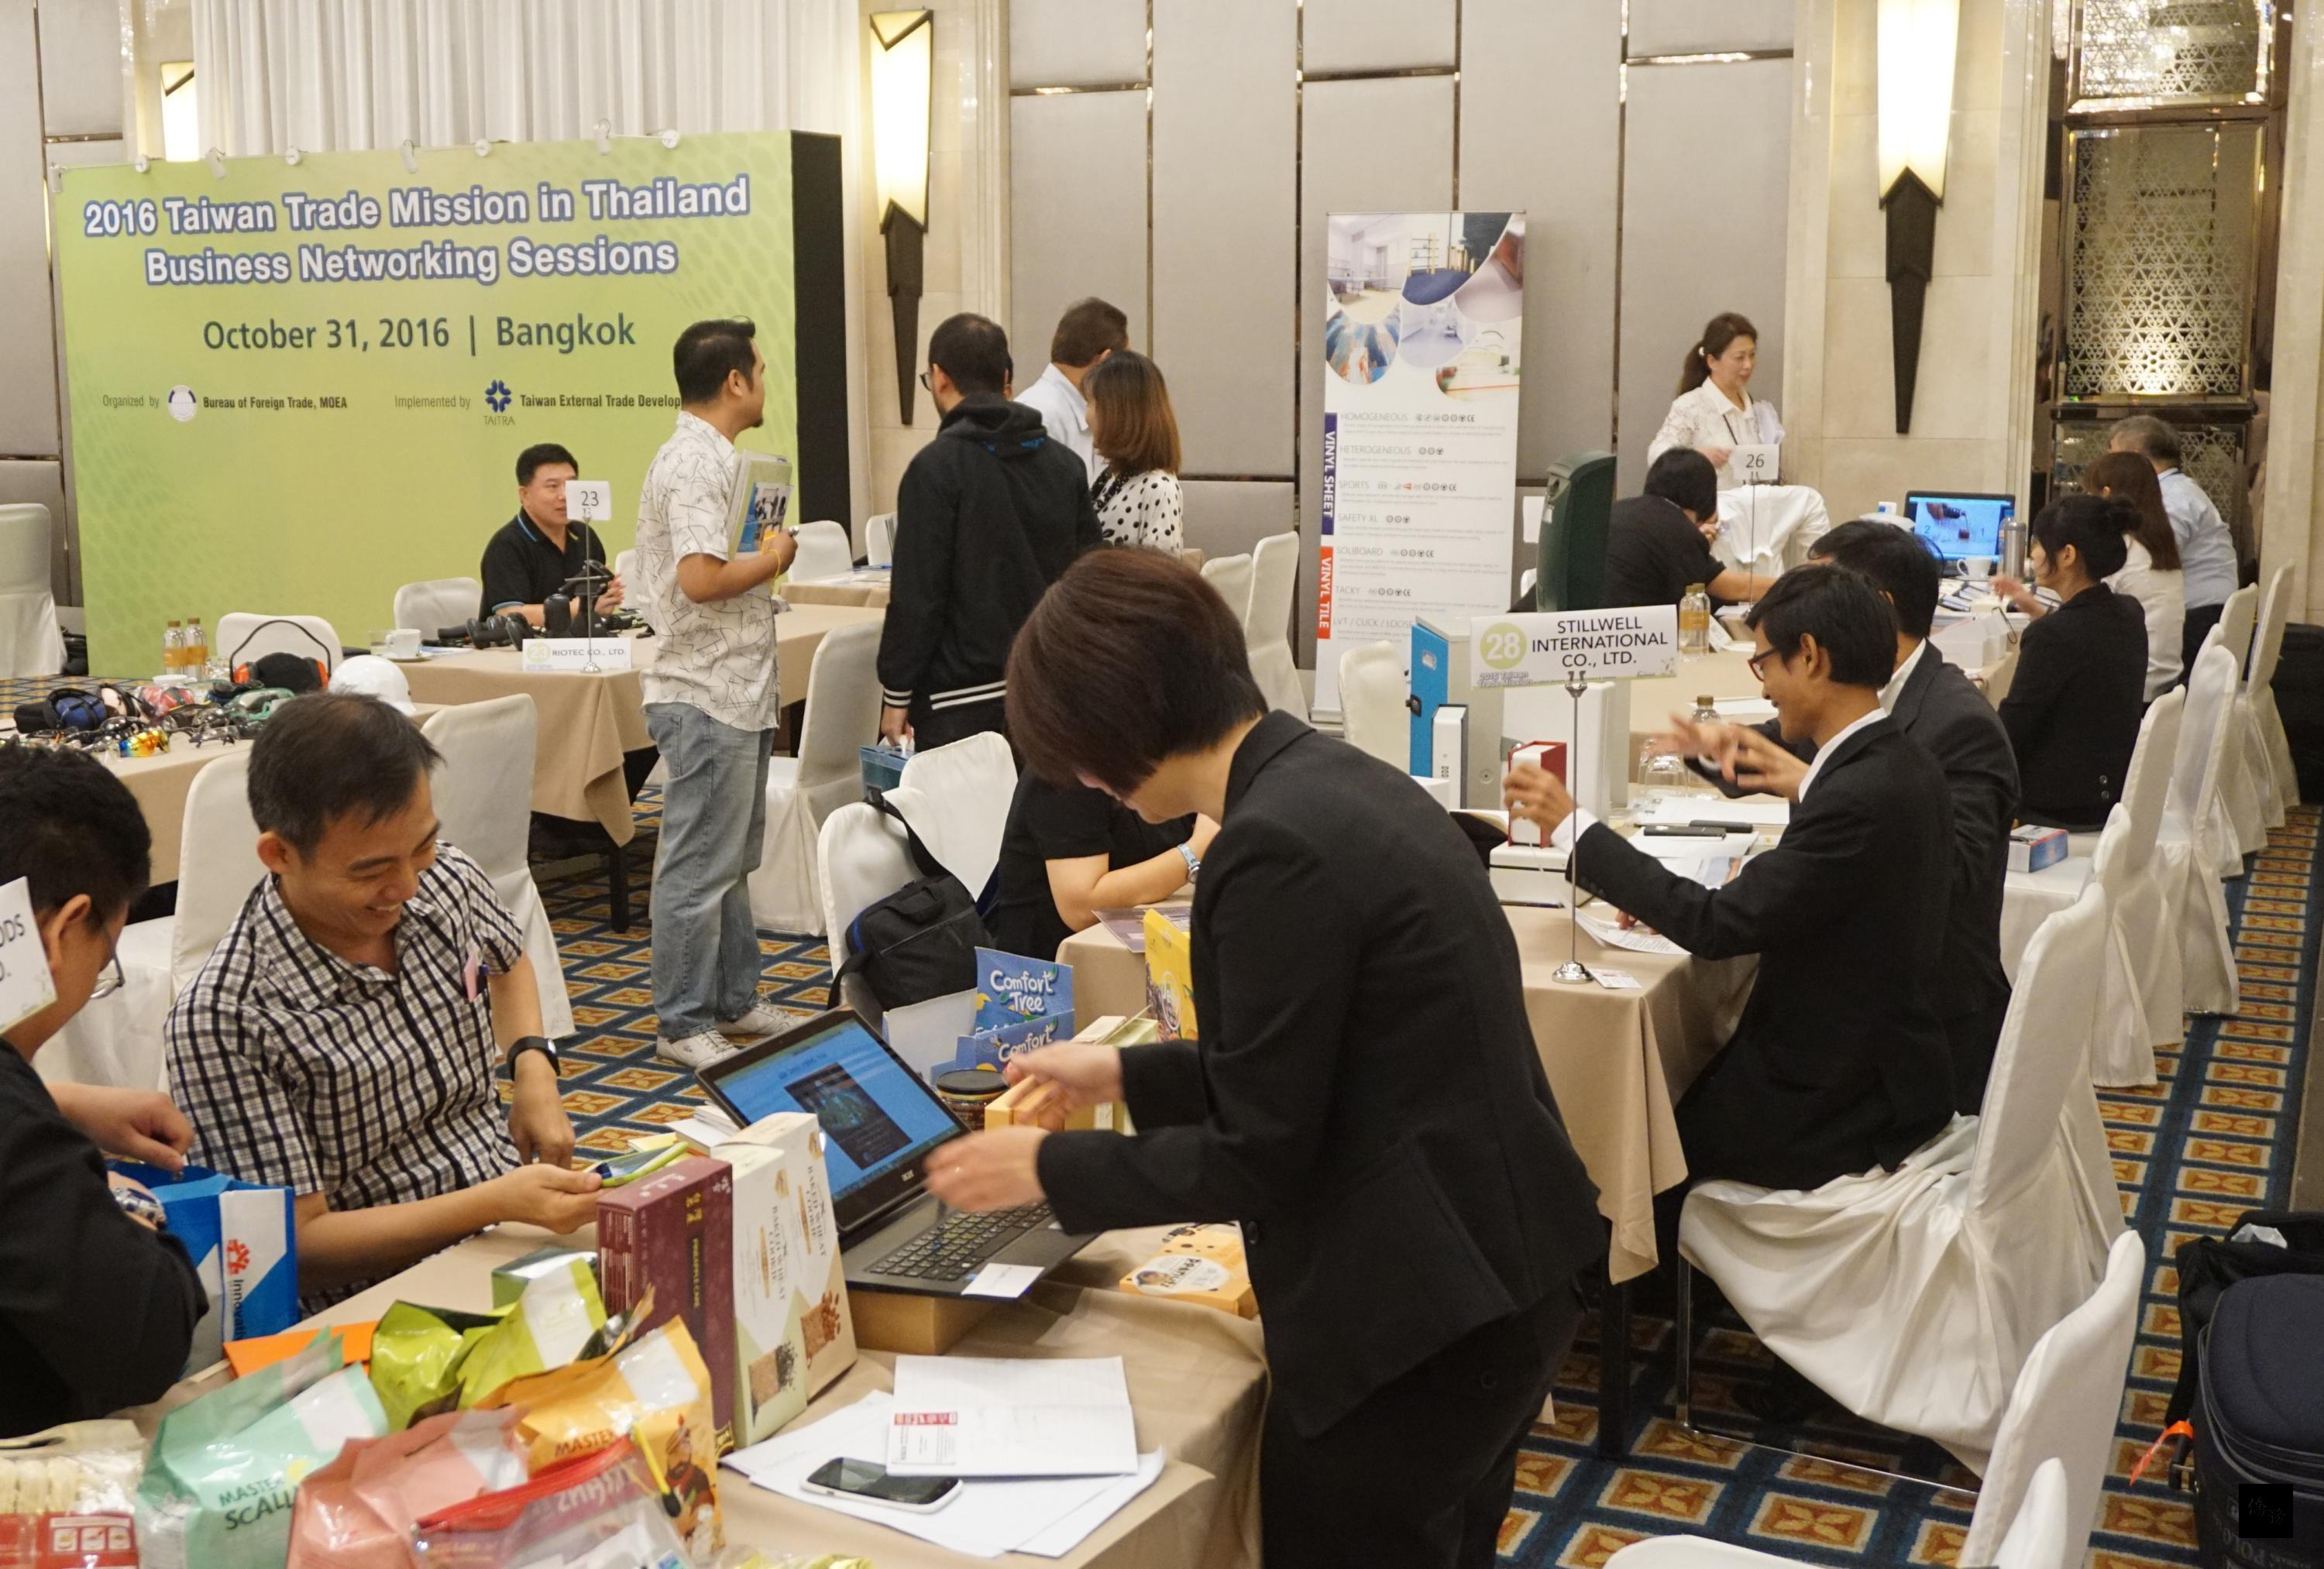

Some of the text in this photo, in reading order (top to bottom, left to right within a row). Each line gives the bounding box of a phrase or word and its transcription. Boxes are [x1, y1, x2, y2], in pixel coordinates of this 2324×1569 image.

[84, 173, 750, 236] 2016 Taiwan Trade Mission in Thailand
[145, 235, 679, 285] Business Networking Sessions
[203, 319, 315, 349] October
[327, 320, 369, 352] 31,
[380, 318, 449, 348] 2016
[497, 312, 635, 354] Bangkok
[103, 395, 160, 409] Organized by
[204, 397, 347, 410] Bureau of Foreign Trade, MOEA
[394, 395, 471, 410] Implemented by
[521, 394, 556, 407] Taiwan
[559, 394, 602, 407] External
[606, 394, 634, 407] Trade
[1340, 413, 1408, 422] HOMOGENEOUS
[1339, 445, 1412, 455] HETEROGENEOUS
[1745, 453, 1765, 469] 26
[1323, 431, 1335, 518] VINYL SHEET
[1339, 481, 1370, 489] SPORTS
[580, 491, 600, 506] 23
[1338, 513, 1378, 522] SAFETY XL
[1318, 557, 1332, 629] VINYL TILE
[1335, 585, 1361, 595] TACKY
[1557, 616, 1643, 634] STILLWELL
[608, 647, 627, 656] LTD.
[1486, 631, 1669, 661] 28 INTERNATIONAL
[1562, 651, 1637, 668] CO., LTD.
[990, 969, 1054, 994] Comfort
[1009, 991, 1046, 1013] Tree
[998, 1023, 1054, 1063] Comfort
[218, 1478, 285, 1507] MASTER
